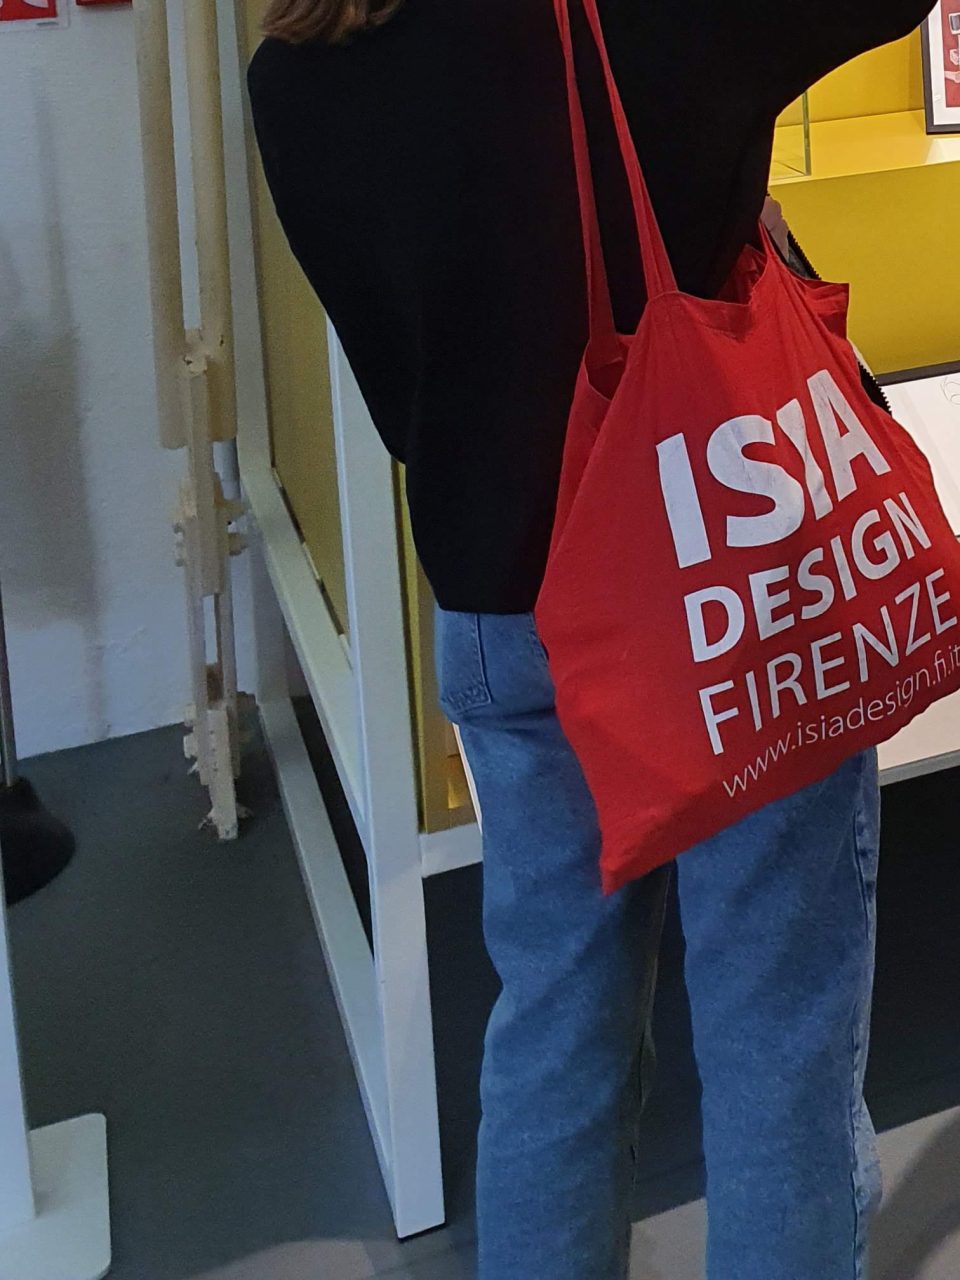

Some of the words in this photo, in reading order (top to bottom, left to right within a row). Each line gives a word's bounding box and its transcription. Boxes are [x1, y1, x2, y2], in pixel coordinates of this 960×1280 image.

[655, 368, 892, 569] ISIA
[684, 491, 932, 664] DESIGN
[698, 567, 958, 756] FIRENZE
